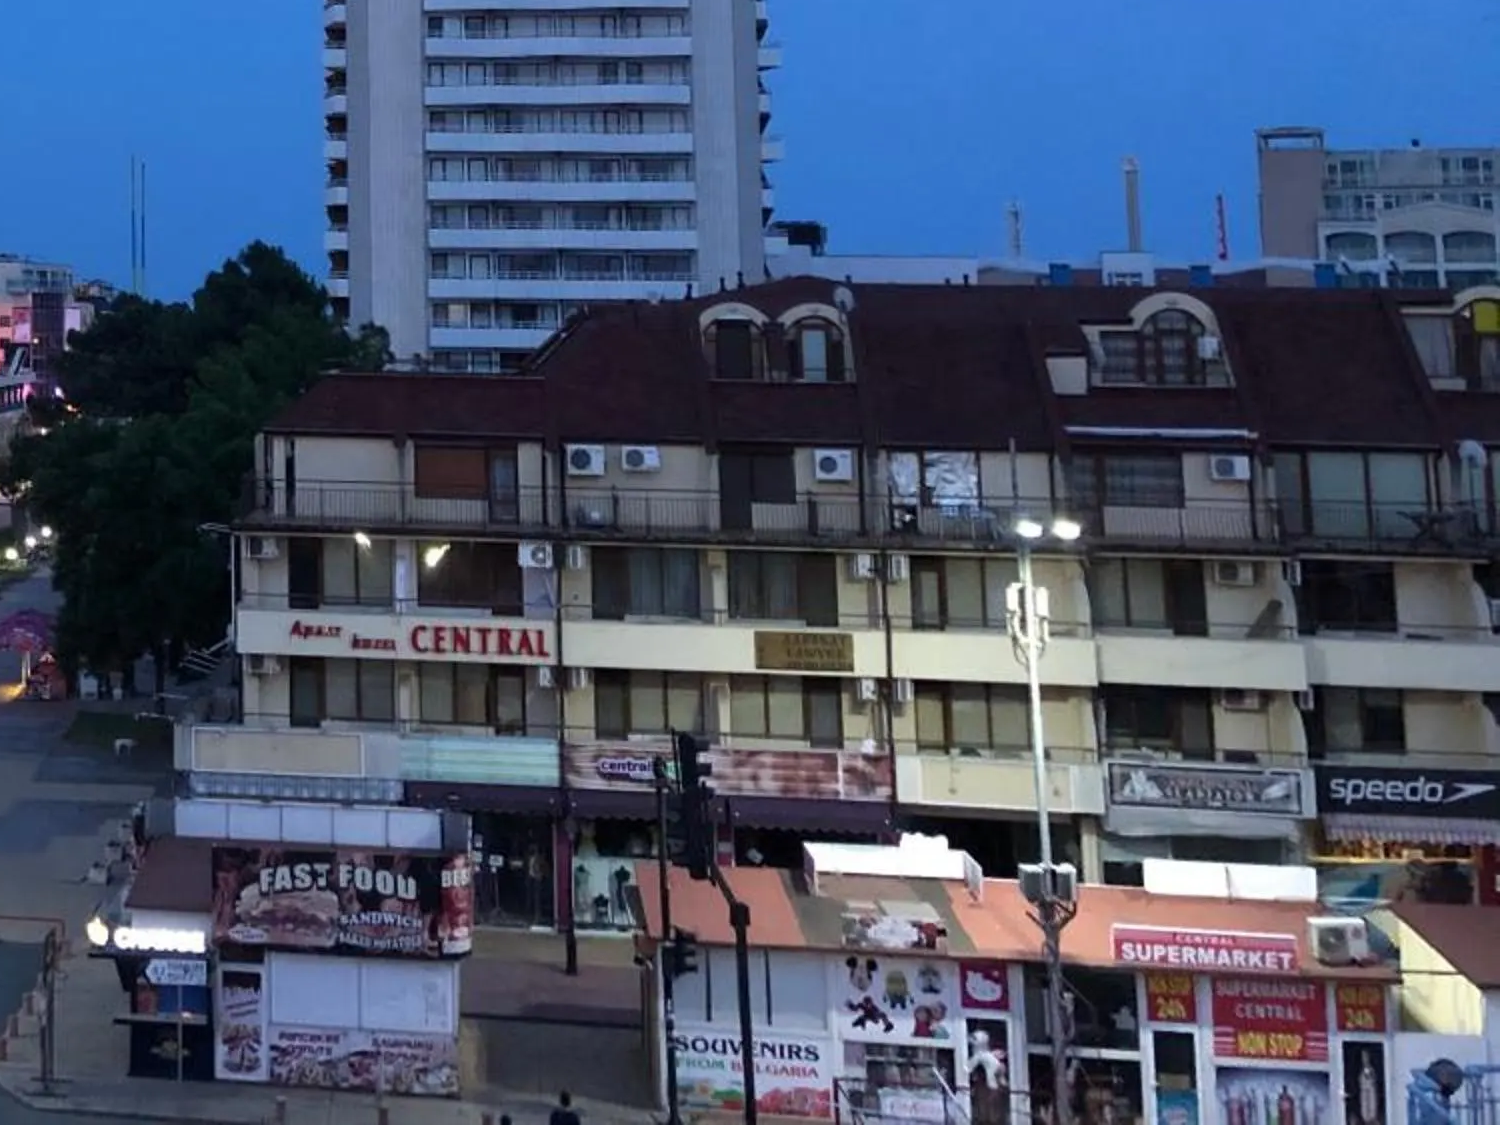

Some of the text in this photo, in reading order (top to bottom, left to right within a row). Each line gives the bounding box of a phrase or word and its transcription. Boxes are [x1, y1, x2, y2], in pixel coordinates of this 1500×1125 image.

[411, 625, 551, 657] CENTRAL
[601, 759, 652, 772] central
[1330, 777, 1444, 806] speedo
[260, 862, 418, 901] FAST FOOD
[340, 911, 423, 930] SANDWICH
[1173, 933, 1235, 945] CENTRAL
[1121, 941, 1293, 970] SUPERMARKET
[1214, 978, 1317, 1000] SUPERMARKET
[1235, 1002, 1306, 1022] CENTRAL
[1236, 1031, 1303, 1057] NON STOP
[731, 1060, 820, 1079] BLGARIA
